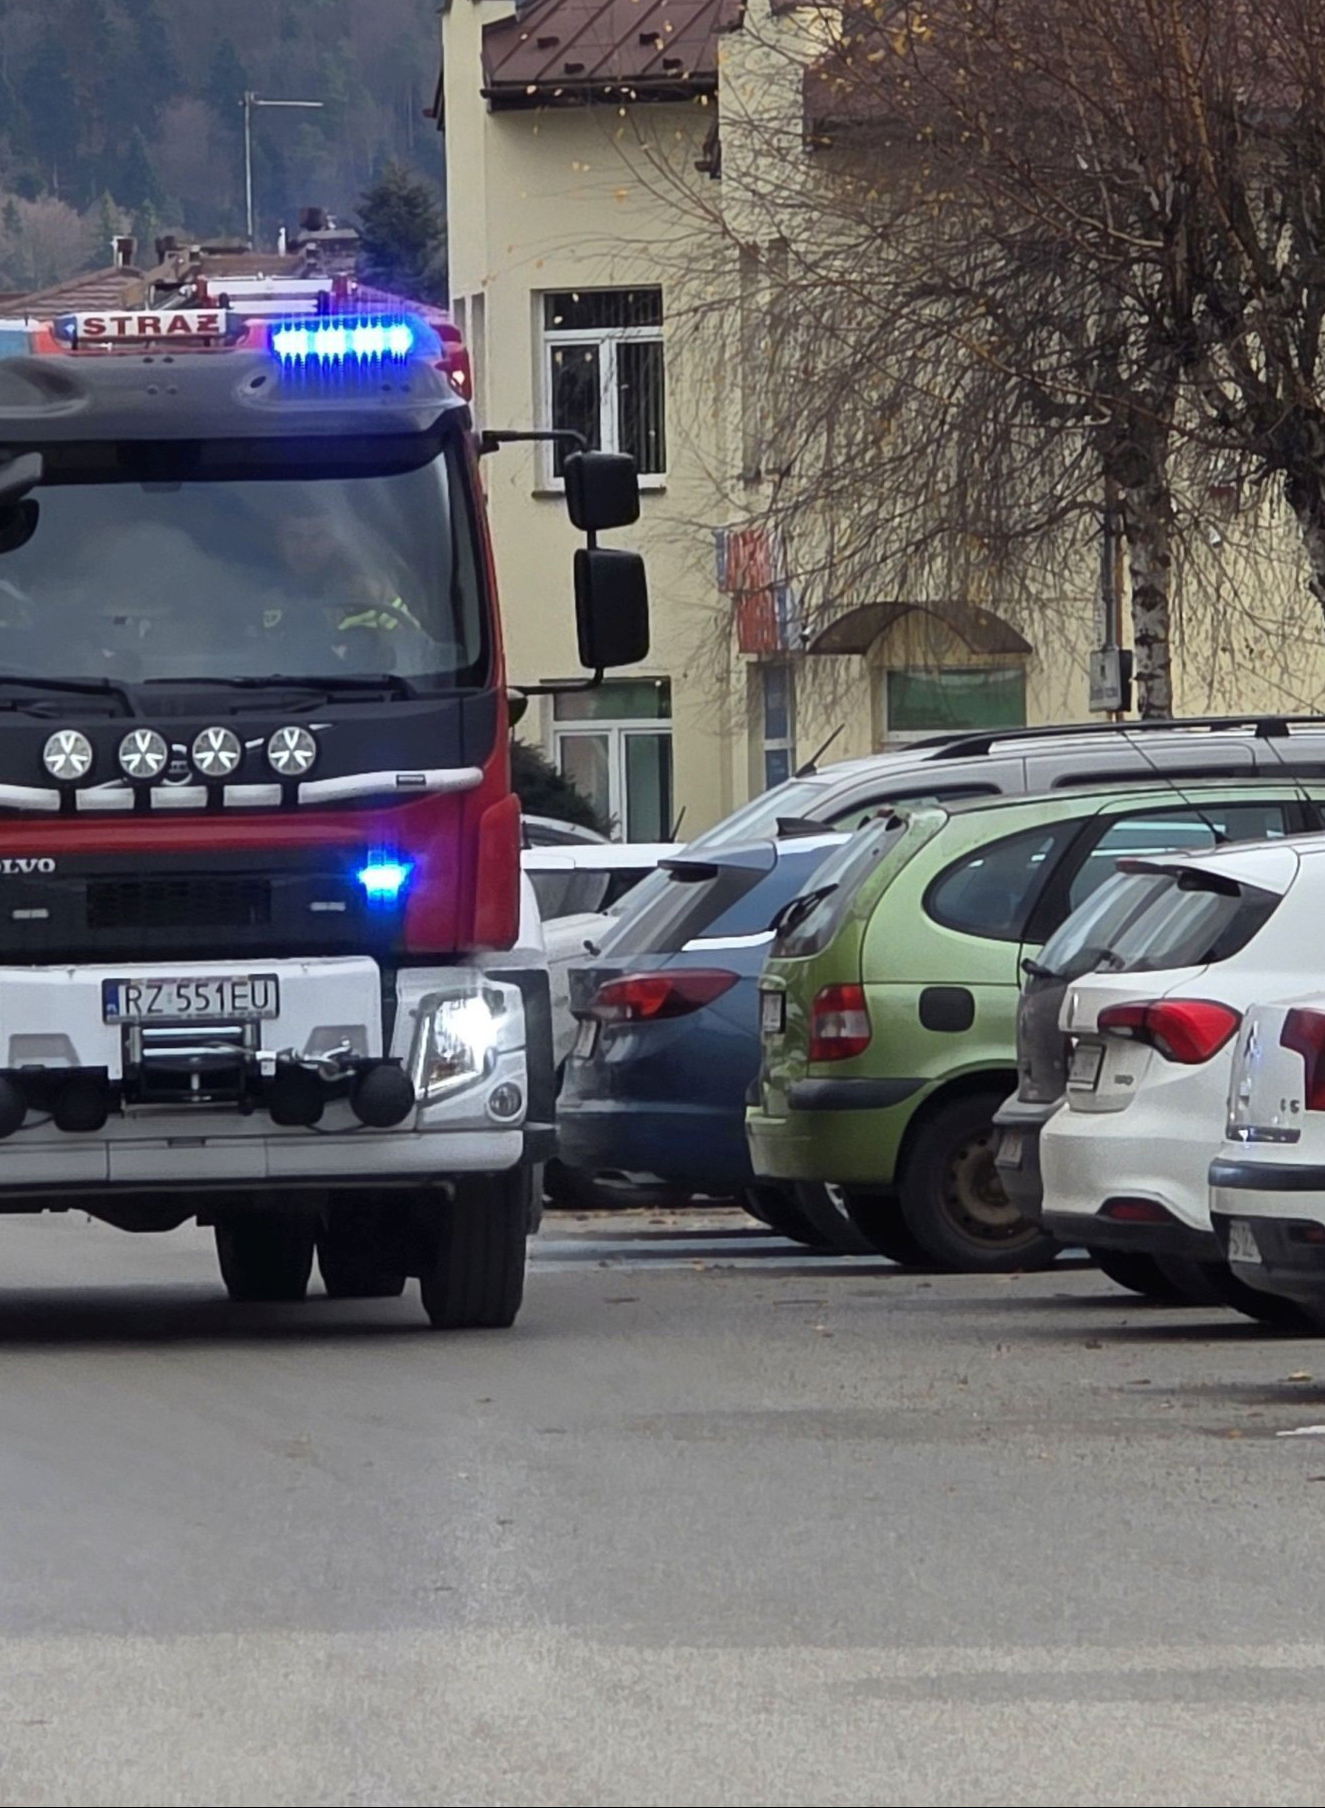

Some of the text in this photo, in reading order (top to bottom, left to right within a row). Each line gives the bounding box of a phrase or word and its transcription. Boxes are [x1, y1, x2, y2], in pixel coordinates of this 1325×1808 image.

[83, 314, 220, 336] STRAŻ
[125, 980, 269, 1015] RZ 551EU
